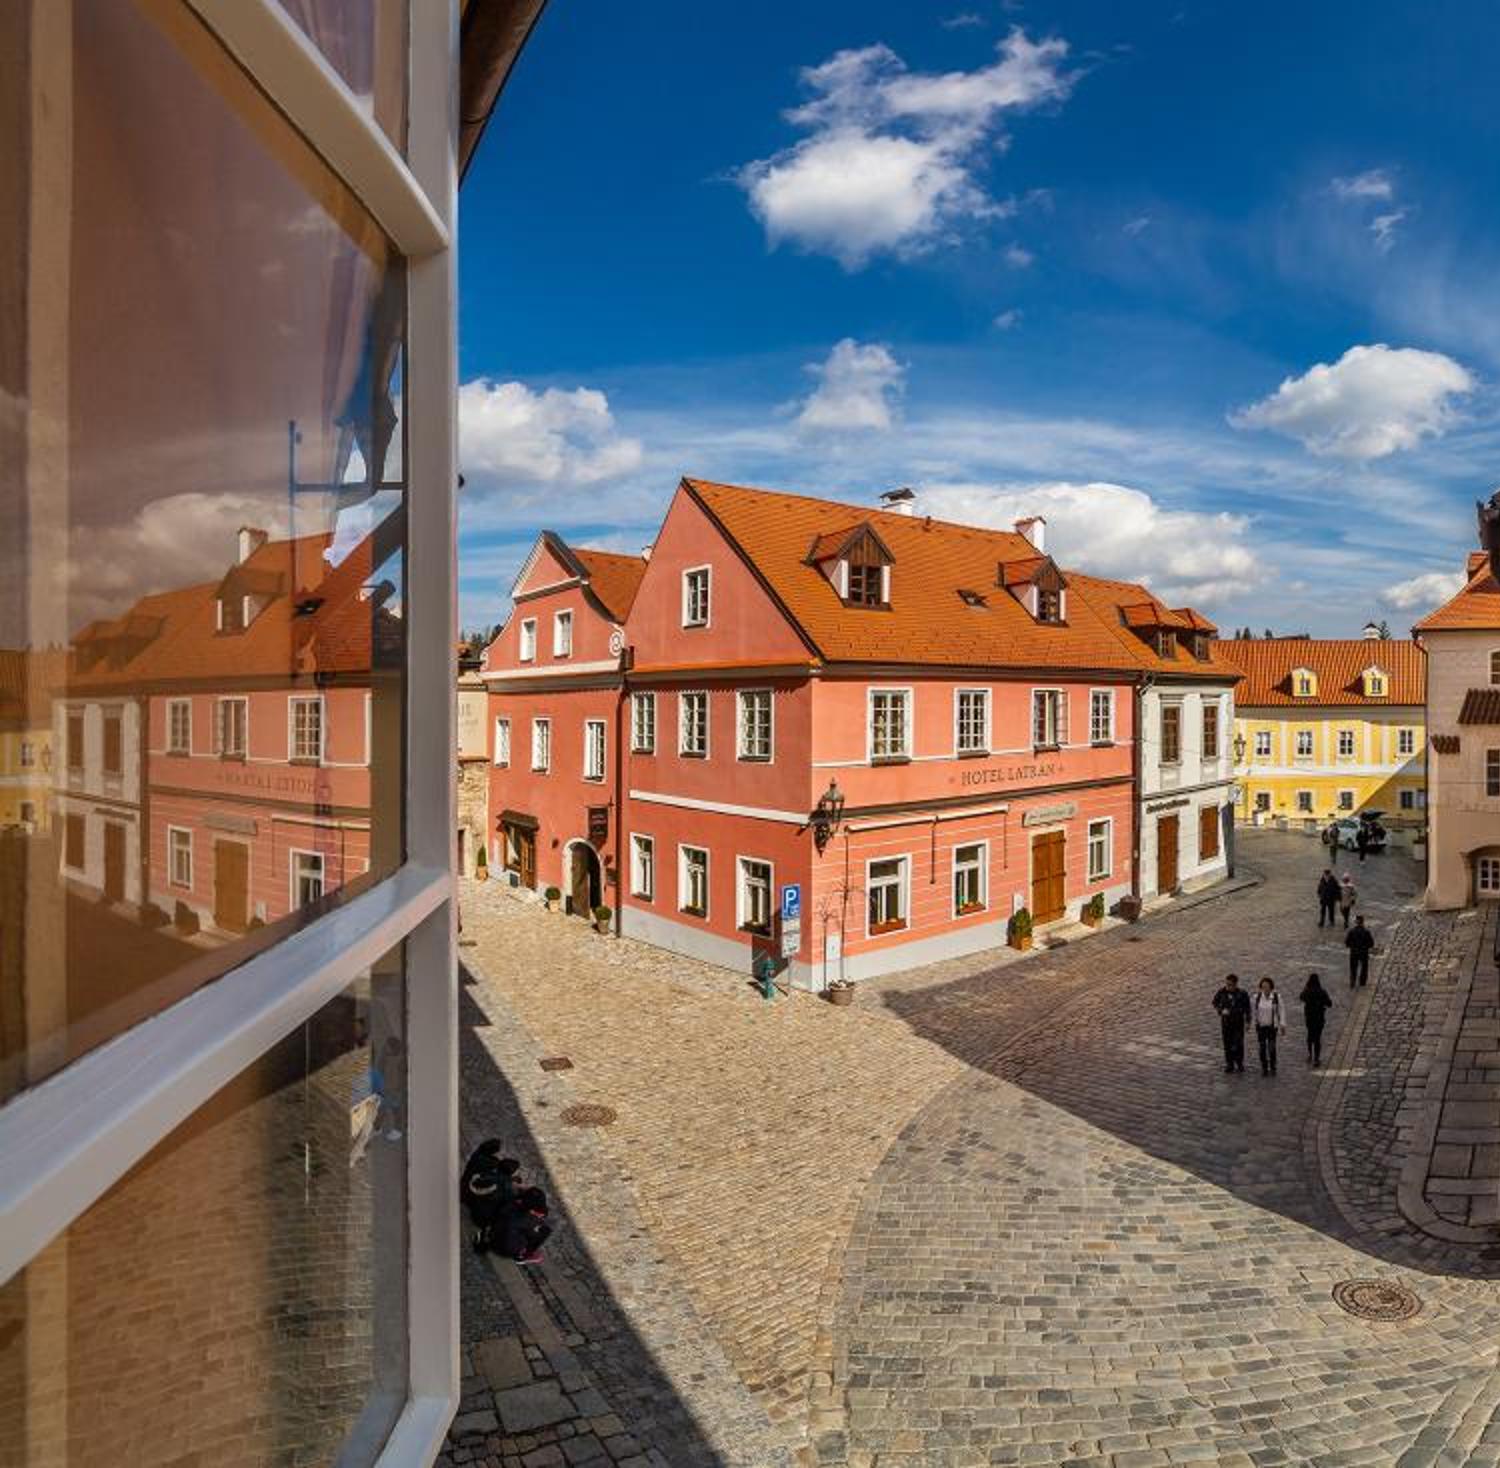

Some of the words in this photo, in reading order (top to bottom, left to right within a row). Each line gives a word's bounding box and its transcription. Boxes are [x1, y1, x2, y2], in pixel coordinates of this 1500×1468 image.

[961, 769, 1005, 786] HOTEL
[1008, 763, 1056, 781] LATRAN
[785, 889, 798, 914] P
